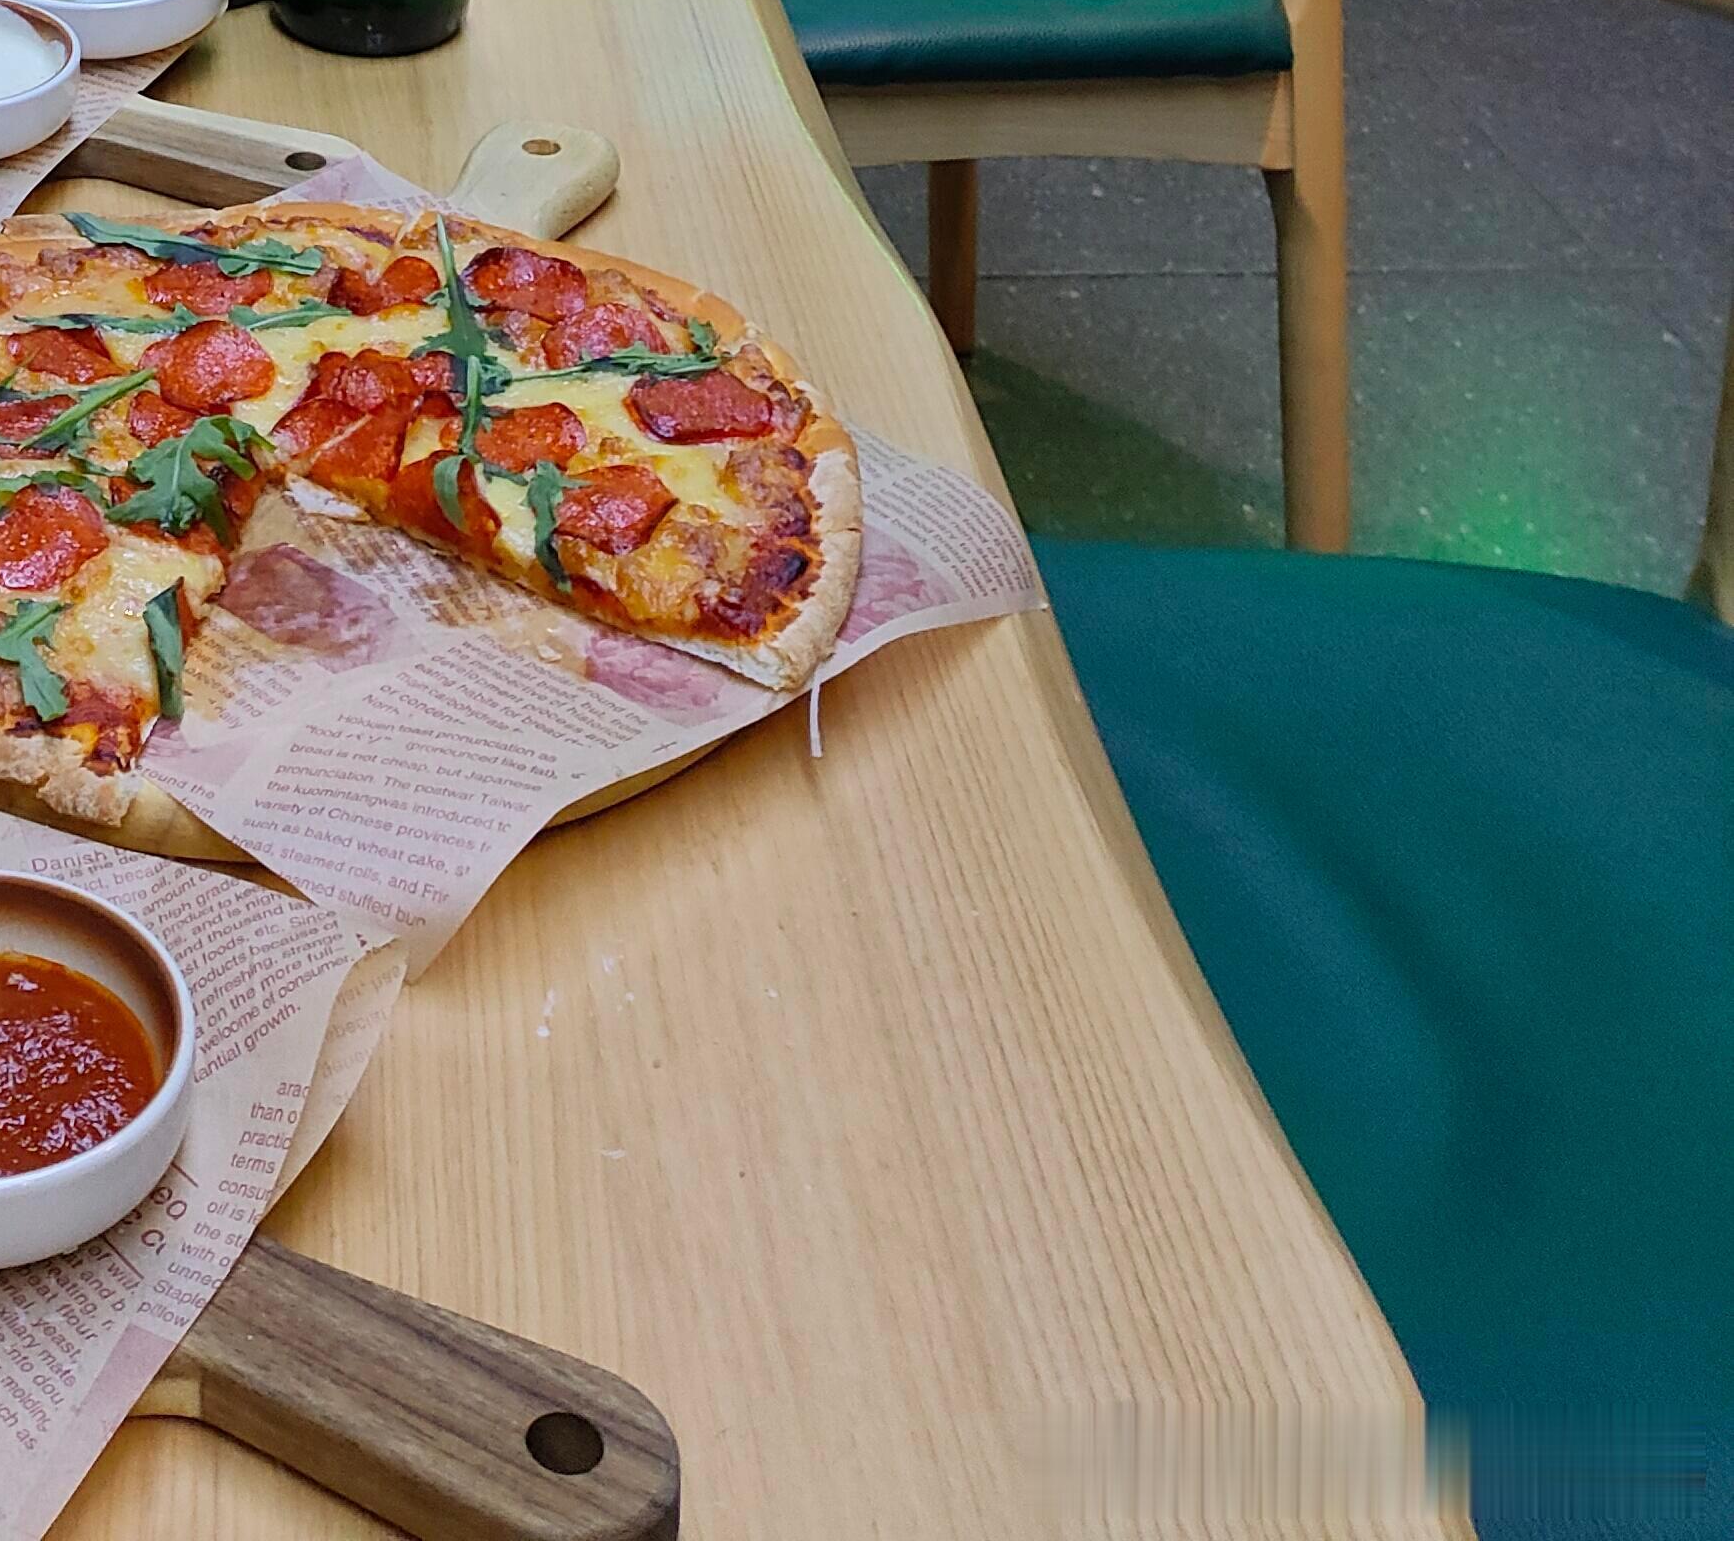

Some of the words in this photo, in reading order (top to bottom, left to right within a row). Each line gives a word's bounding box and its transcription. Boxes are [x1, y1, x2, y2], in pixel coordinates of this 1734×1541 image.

[289, 742, 334, 760] bread
[351, 751, 377, 765] not
[436, 764, 463, 779] but
[465, 770, 543, 794] Japanese
[436, 730, 537, 761] pronunciation
[500, 755, 528, 773] like
[266, 779, 291, 794] the
[411, 801, 495, 832] introduced
[382, 775, 411, 792] The
[413, 781, 475, 803] postwar
[241, 816, 279, 832] such
[303, 825, 353, 850] baked
[355, 840, 406, 863] wheat
[406, 852, 449, 875] cake,
[254, 797, 304, 817] variety
[326, 806, 394, 833] Chinese
[395, 823, 476, 854] provinces
[30, 849, 108, 874] Danish
[278, 847, 346, 875] steamed
[387, 874, 419, 896] and
[336, 888, 394, 918] stuffed
[202, 937, 250, 966] foods,
[288, 908, 338, 929] Since
[248, 925, 322, 958] because
[198, 954, 281, 1010] refreshing,
[281, 931, 345, 960] strange
[228, 985, 257, 1010] the
[259, 958, 304, 993] more
[197, 1005, 263, 1057] welcome
[276, 953, 356, 1000] consumer.
[242, 1003, 303, 1054] growth.
[230, 1152, 276, 1175] terms
[179, 1239, 217, 1264] with
[29, 1313, 84, 1367] yeast,
[15, 1424, 38, 1453] as
